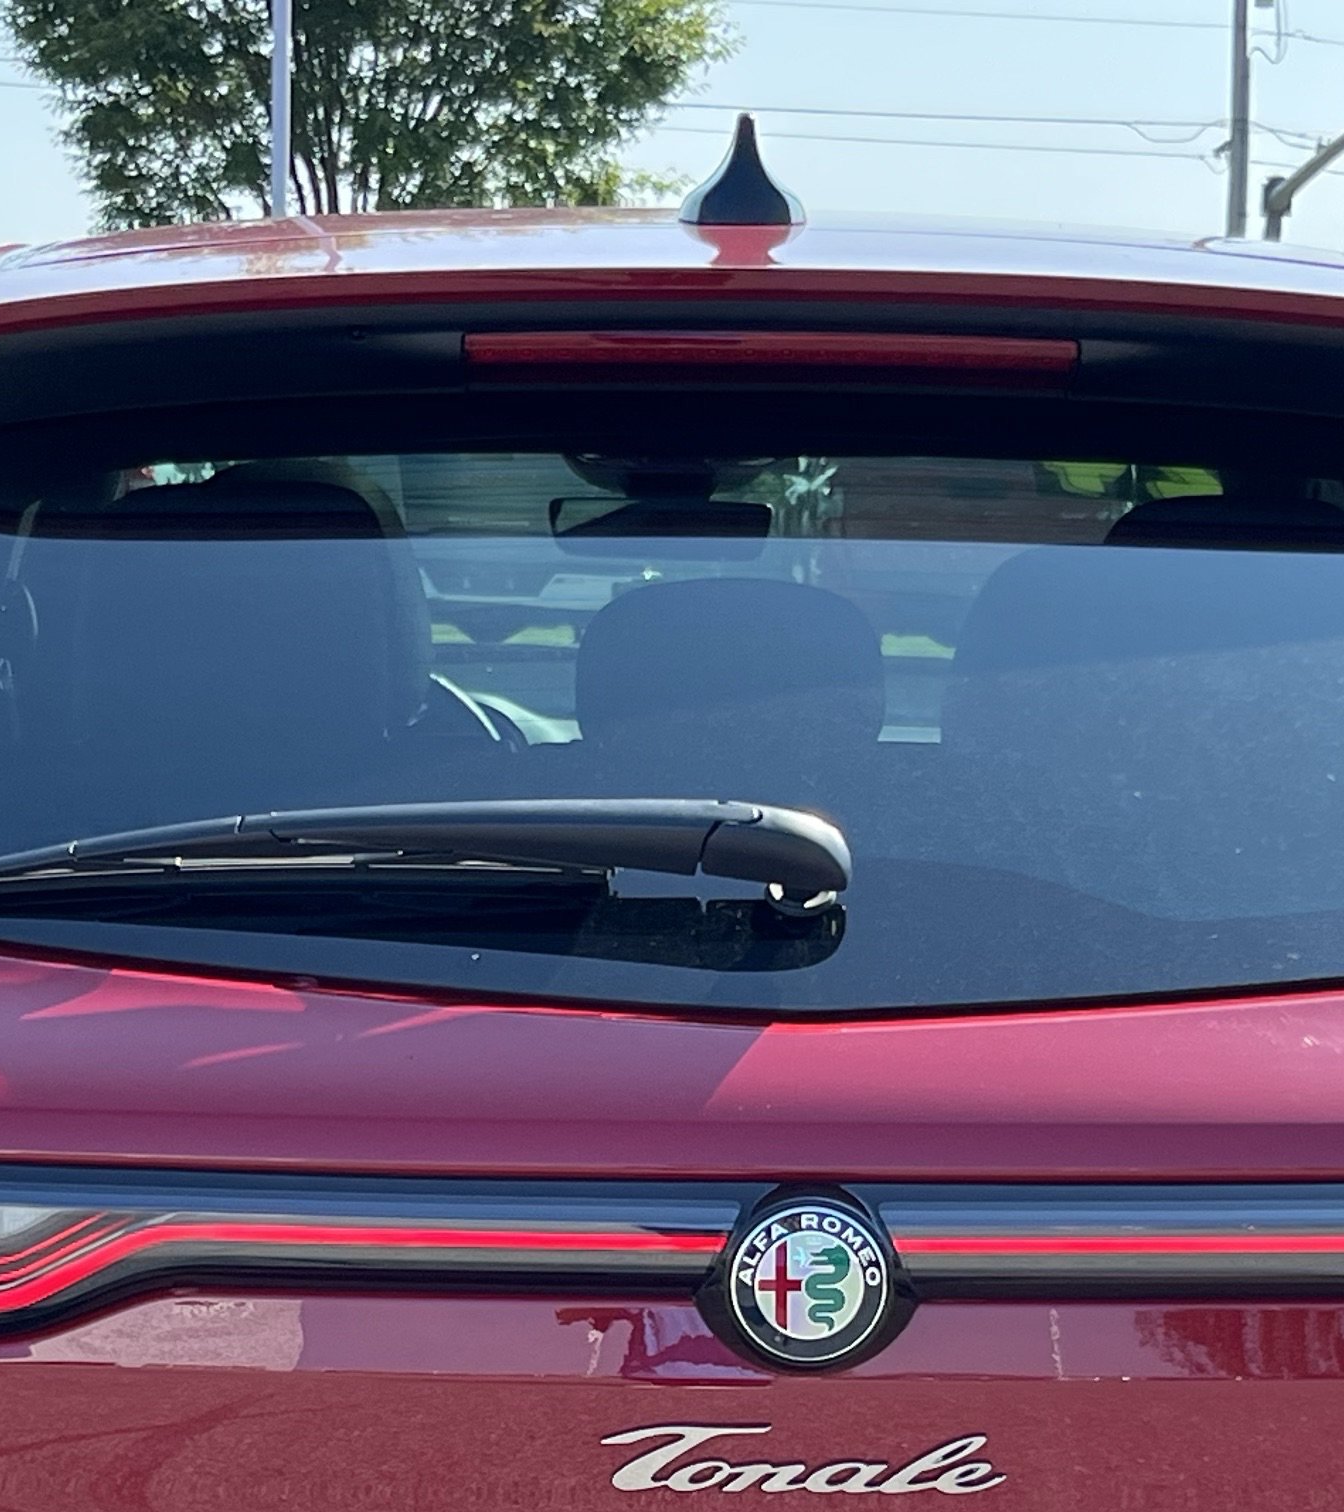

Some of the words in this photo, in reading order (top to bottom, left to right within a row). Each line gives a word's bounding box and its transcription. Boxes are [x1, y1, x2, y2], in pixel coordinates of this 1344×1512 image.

[738, 1223, 791, 1287] ALFA
[799, 1213, 882, 1288] ROMEO
[600, 1422, 1007, 1495] Tonale
